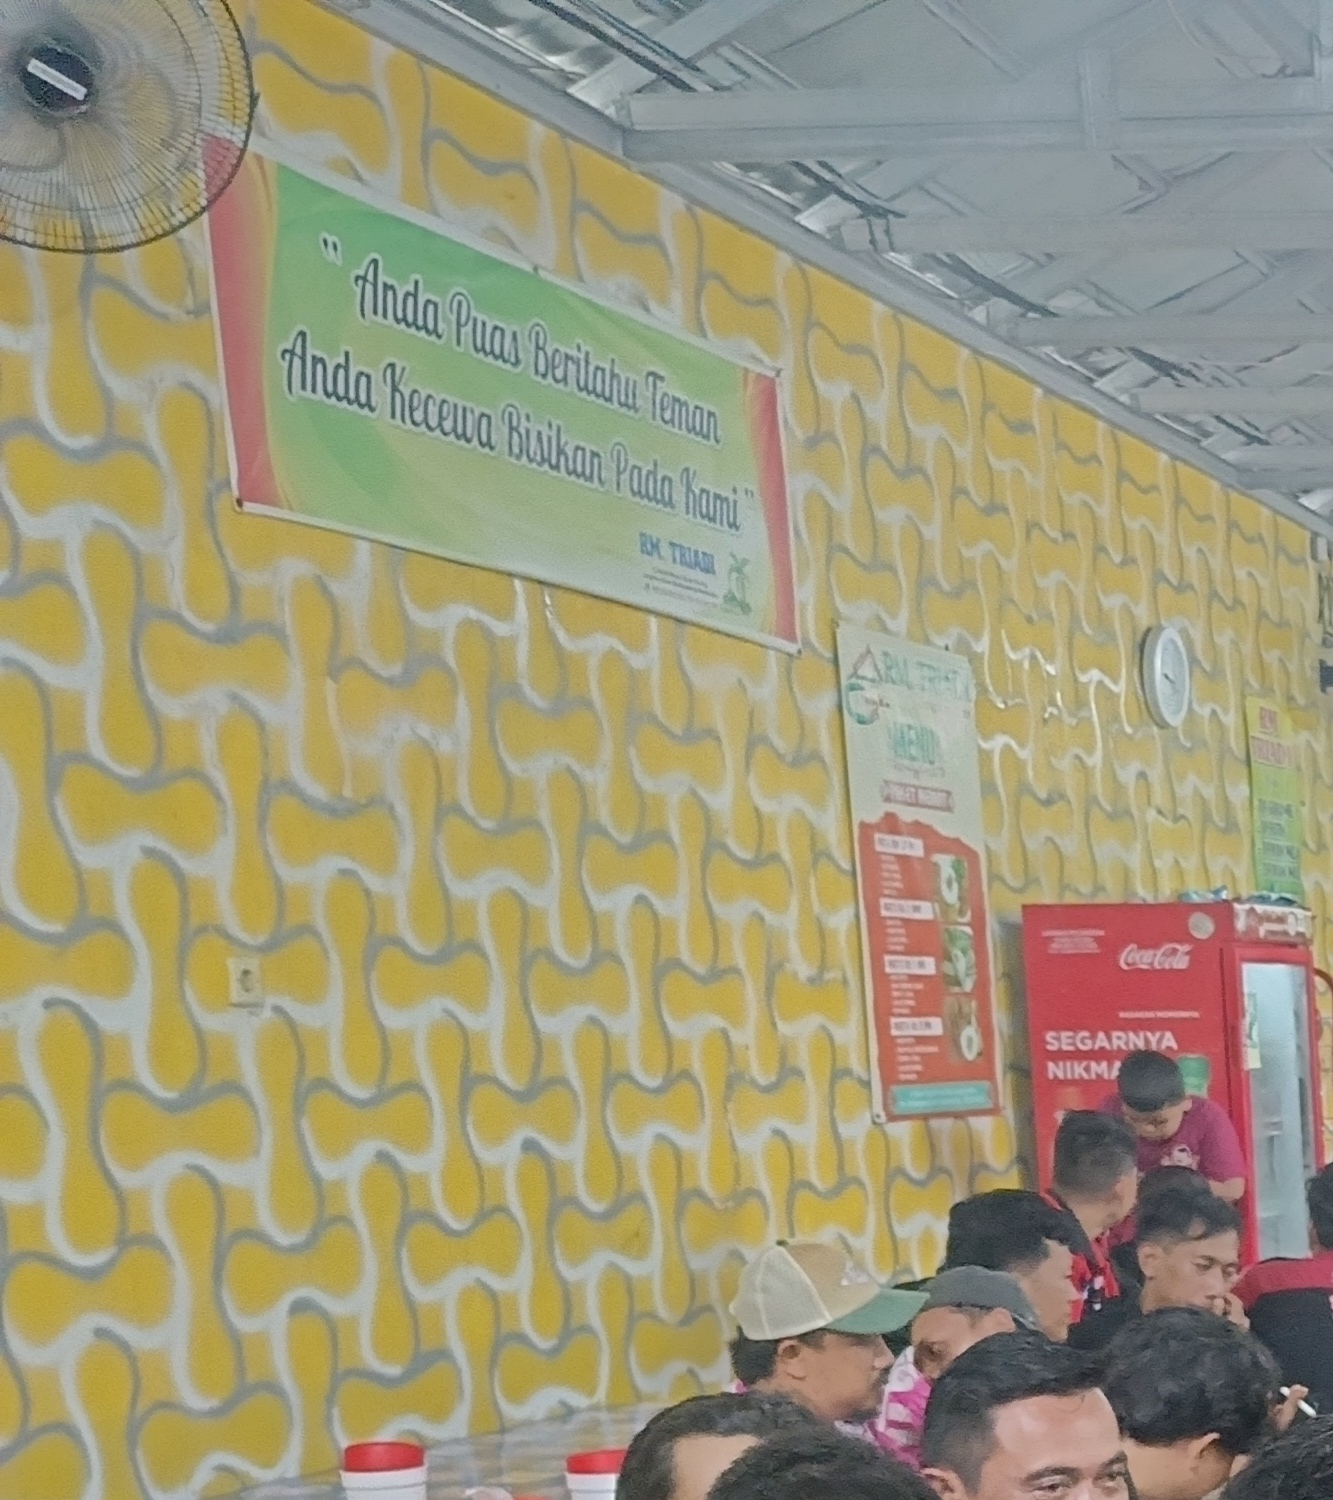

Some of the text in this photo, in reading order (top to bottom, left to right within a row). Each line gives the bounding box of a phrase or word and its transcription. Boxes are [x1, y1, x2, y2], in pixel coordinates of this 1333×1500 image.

[355, 258, 443, 340] Anda
[450, 292, 521, 367] Puas
[528, 323, 639, 413] Beritahu
[646, 370, 720, 444] Teman
[281, 330, 376, 413] Anda
[383, 362, 495, 450] Kecewa
[502, 404, 605, 487] Bisikan
[611, 442, 676, 510] Pada
[1119, 943, 1193, 971] Coca-Cola
[1045, 1030, 1178, 1051] SEGARNYA
